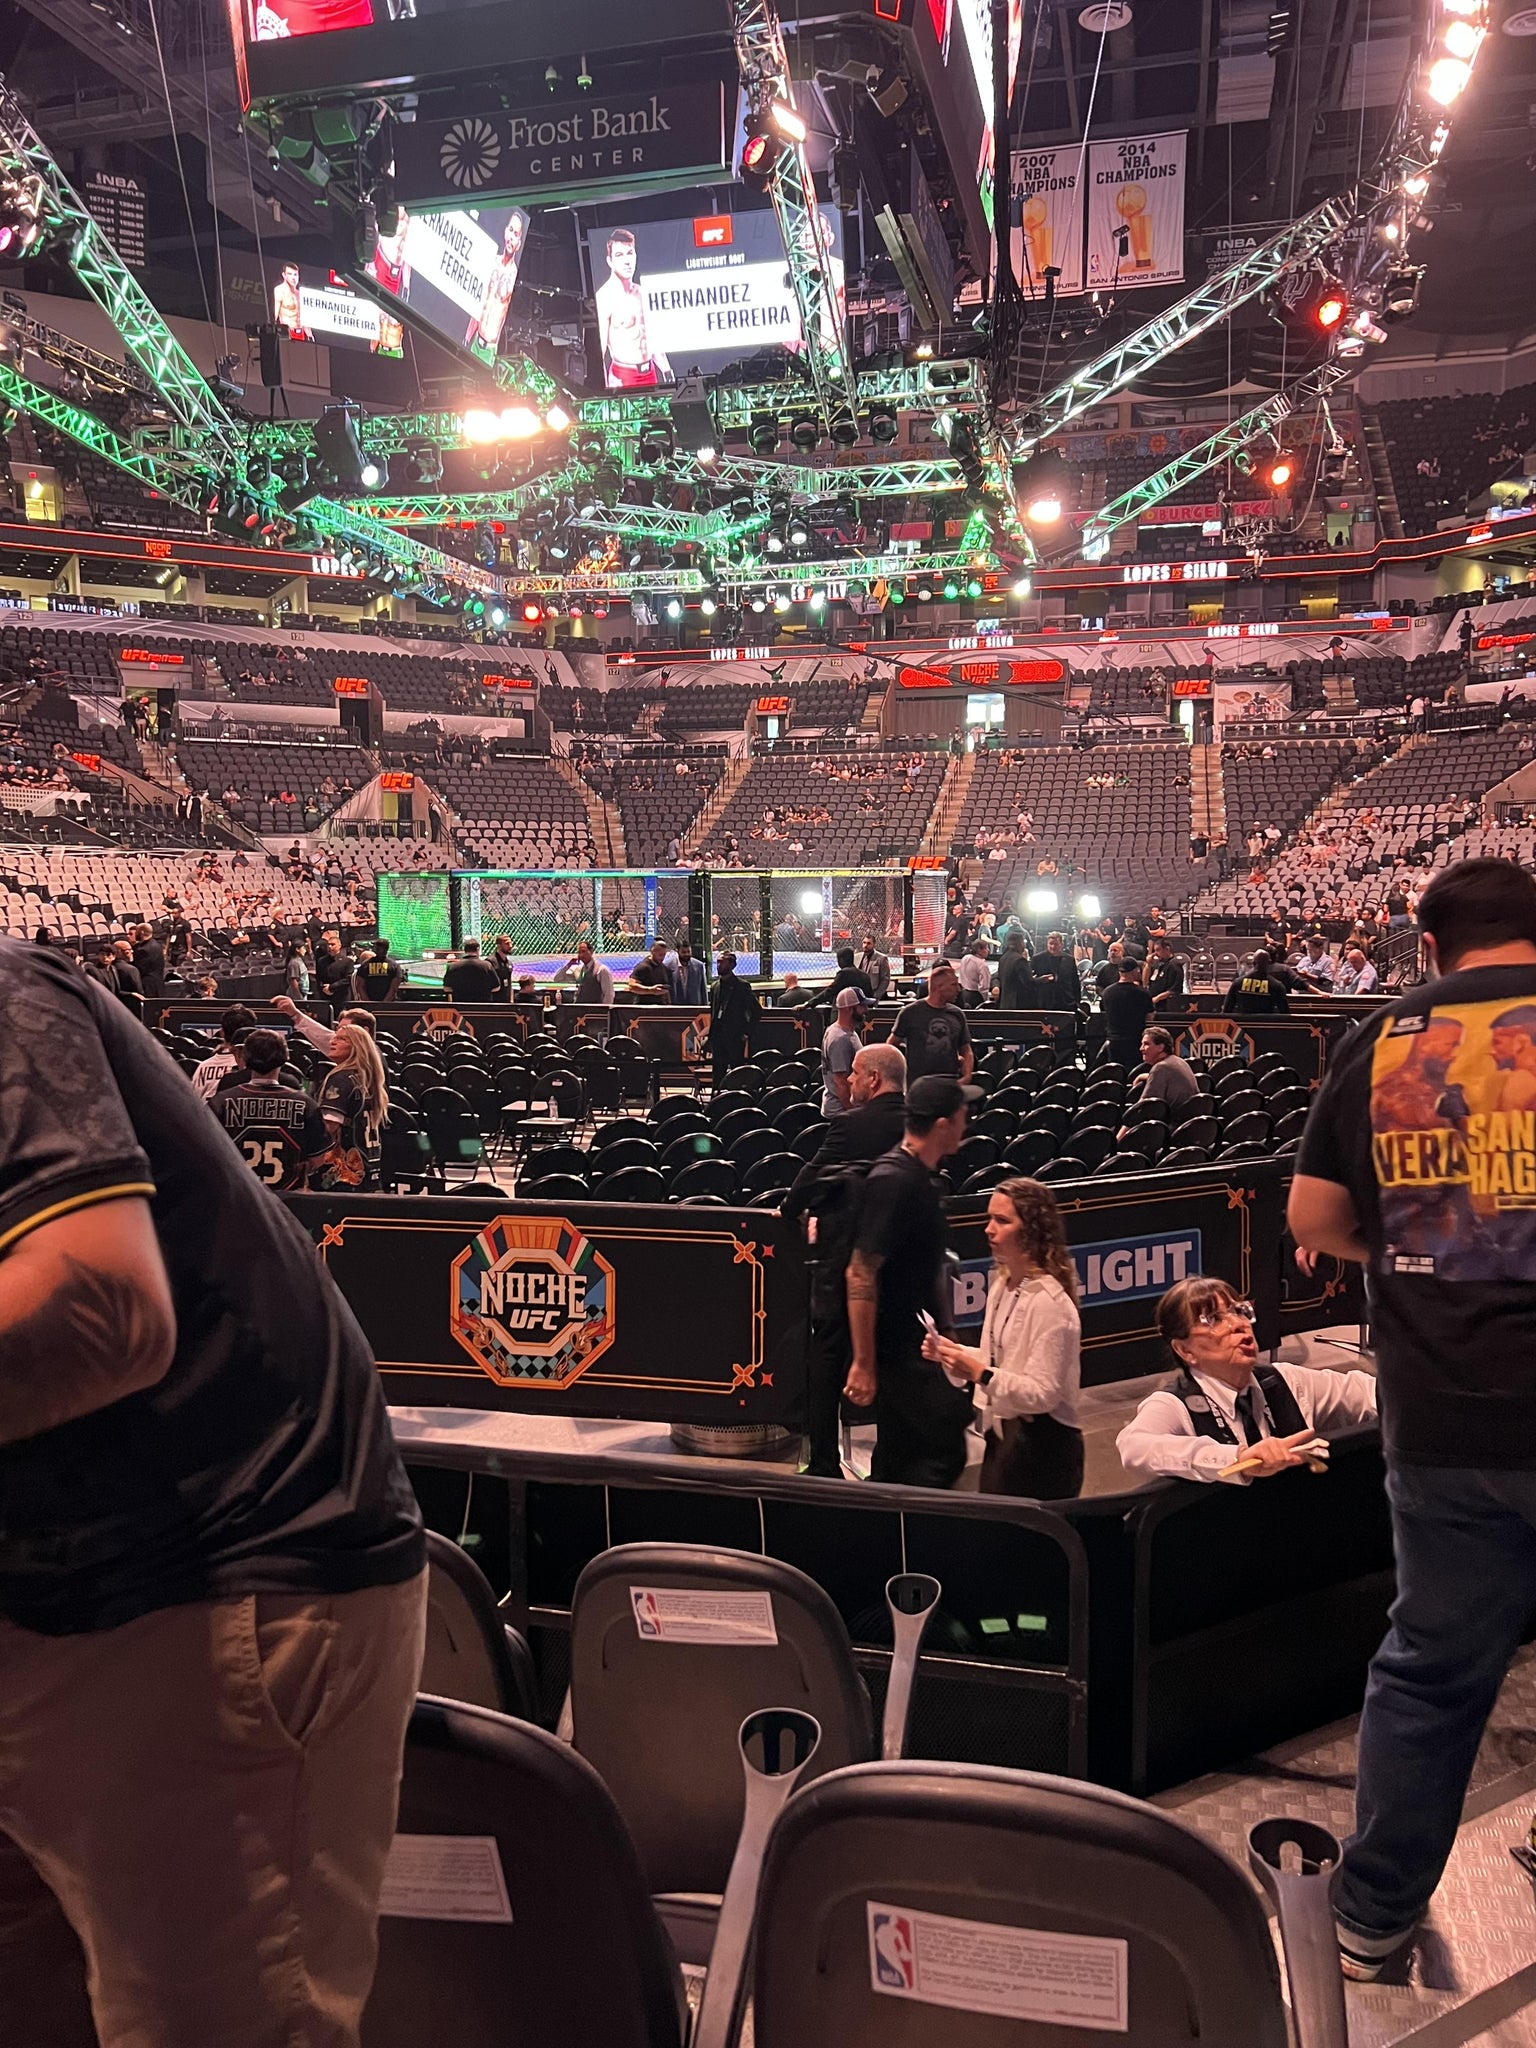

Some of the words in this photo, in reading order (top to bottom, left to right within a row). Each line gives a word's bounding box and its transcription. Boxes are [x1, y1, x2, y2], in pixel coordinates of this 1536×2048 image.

[508, 114, 584, 149] Frost
[590, 96, 671, 140] Bank
[1117, 141, 1156, 157] 2014
[530, 147, 643, 174] CENTER
[1019, 154, 1057, 168] 2007
[1123, 155, 1151, 170] NBA
[102, 174, 138, 190] NBA
[1023, 167, 1051, 181] NBA
[1096, 163, 1177, 185] CHAMPIONS
[1222, 237, 1257, 249] NBA
[440, 251, 484, 303] FERREIRA
[1110, 273, 1149, 283] ANTONIO
[1151, 270, 1180, 278] SPURS
[303, 296, 357, 316] HERNANDEZ
[649, 283, 751, 312] HERNANDEZ
[333, 315, 376, 331] FERREIRA
[707, 304, 791, 331] FERREIRA
[145, 541, 172, 556] NOCHE
[311, 556, 359, 577] LOPES
[1123, 565, 1171, 582] LOPES
[1183, 561, 1228, 579] SILVA
[18, 611, 33, 620] 125
[1207, 626, 1240, 637] LOPES
[1247, 624, 1279, 636] SILVA
[949, 638, 977, 650] LOPES
[986, 636, 1014, 648] SILVA
[122, 648, 149, 661] UFC
[710, 648, 738, 661] LOPES
[745, 646, 770, 659] SILVA
[961, 663, 999, 680] NOCHE
[334, 676, 369, 693] UFC
[1174, 679, 1211, 695] UFC
[757, 695, 789, 711] UFC
[381, 771, 414, 789] UFC
[153, 796, 163, 805] 25
[907, 856, 947, 871] UFC
[647, 890, 655, 908] BUD
[647, 909, 655, 937] LIGHT
[1241, 977, 1269, 993] HPA
[1189, 1042, 1241, 1059] NOCHE
[225, 1097, 306, 1129] NOCHE
[243, 1140, 284, 1184] 25
[1376, 1132, 1470, 1183] VERA
[479, 1270, 588, 1319] NOCHE
[509, 1308, 561, 1331] UFC
